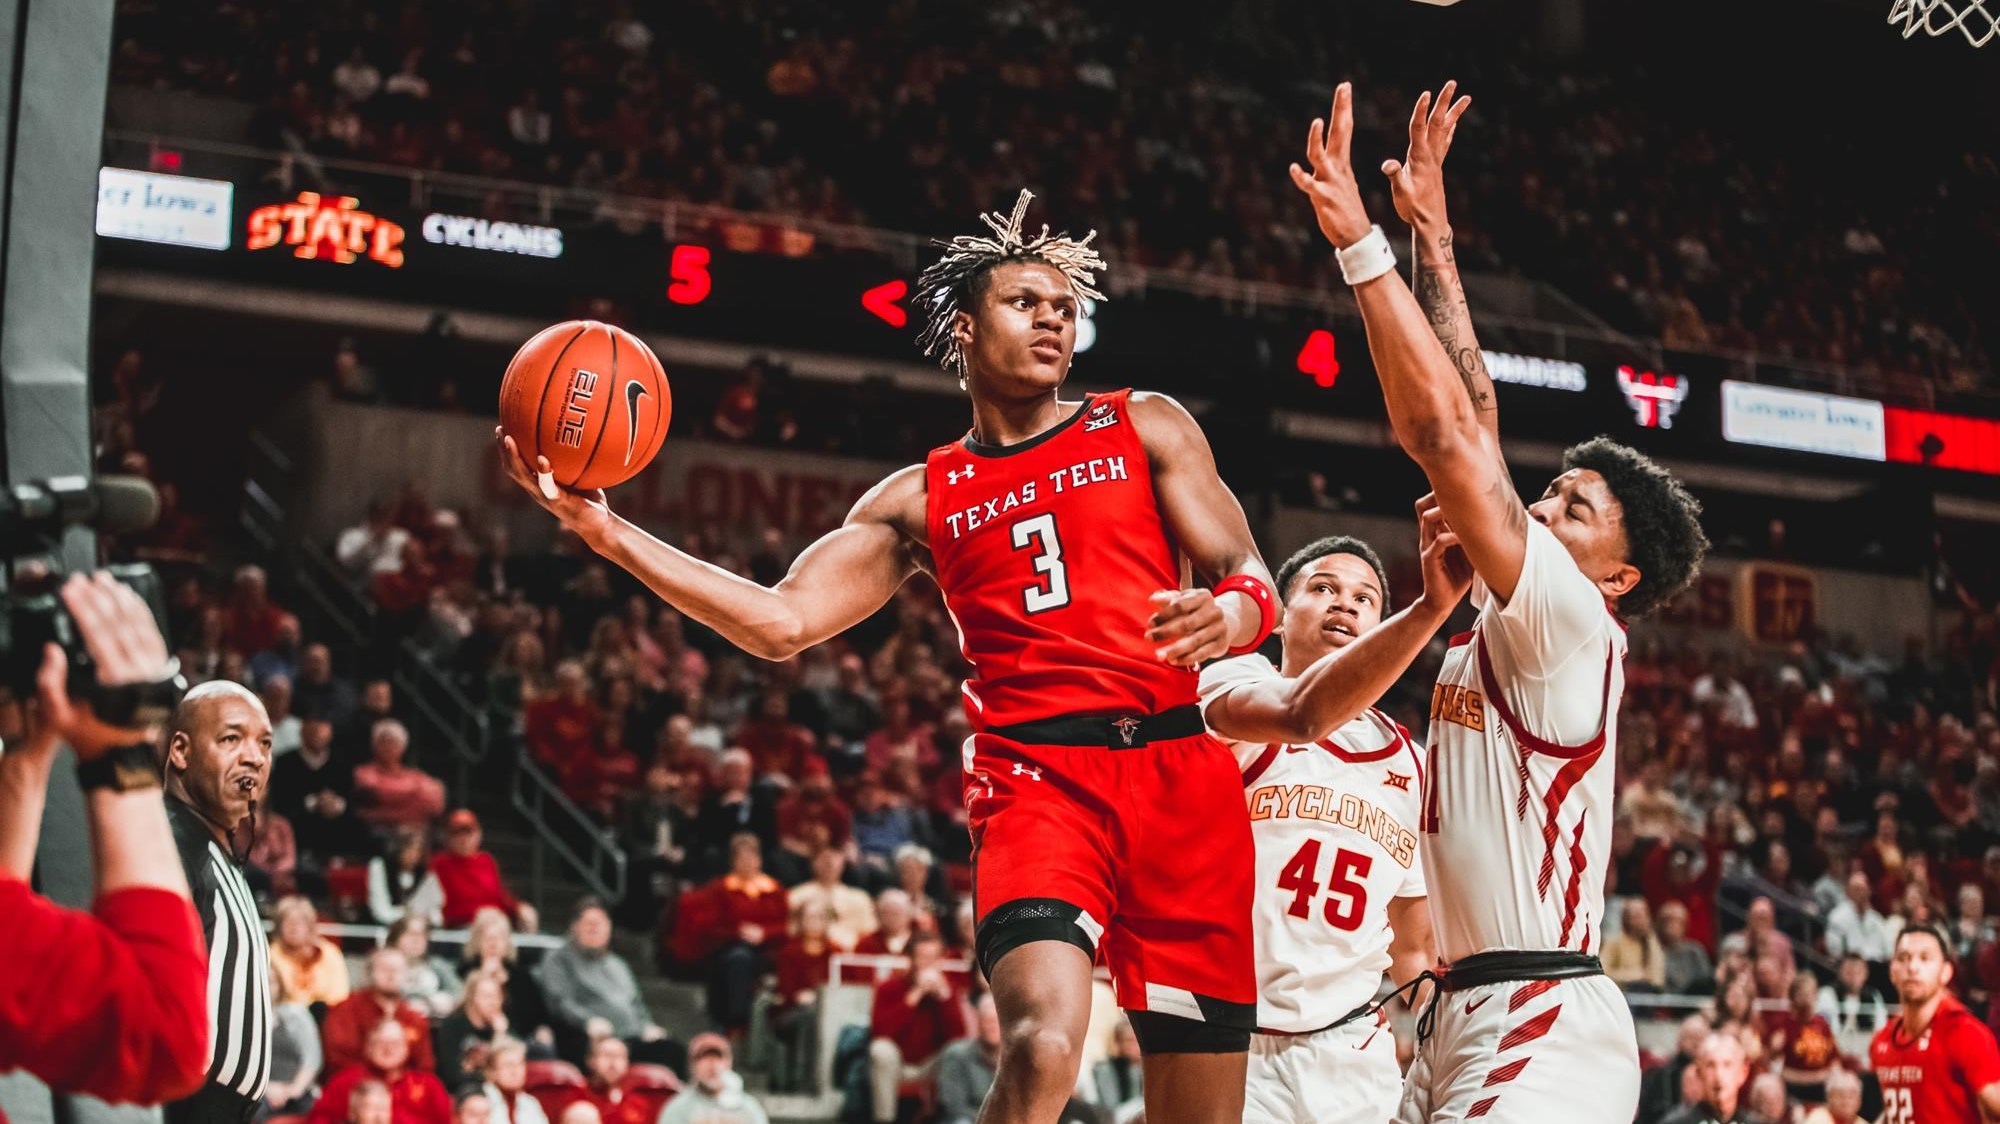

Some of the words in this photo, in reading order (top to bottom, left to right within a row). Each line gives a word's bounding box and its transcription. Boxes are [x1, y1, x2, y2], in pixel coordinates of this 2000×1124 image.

[247, 196, 405, 268] STATE
[422, 212, 563, 259] CYCLONES
[667, 244, 712, 305] 5
[1297, 329, 1340, 388] 4
[560, 369, 599, 449] ELITE
[946, 481, 1036, 539] TEXAS
[1049, 456, 1127, 493] TECH
[1010, 510, 1071, 615] 3
[1250, 784, 1417, 869] CYCLONES
[1276, 838, 1373, 932] 45
[1884, 1087, 1915, 1124] 22
